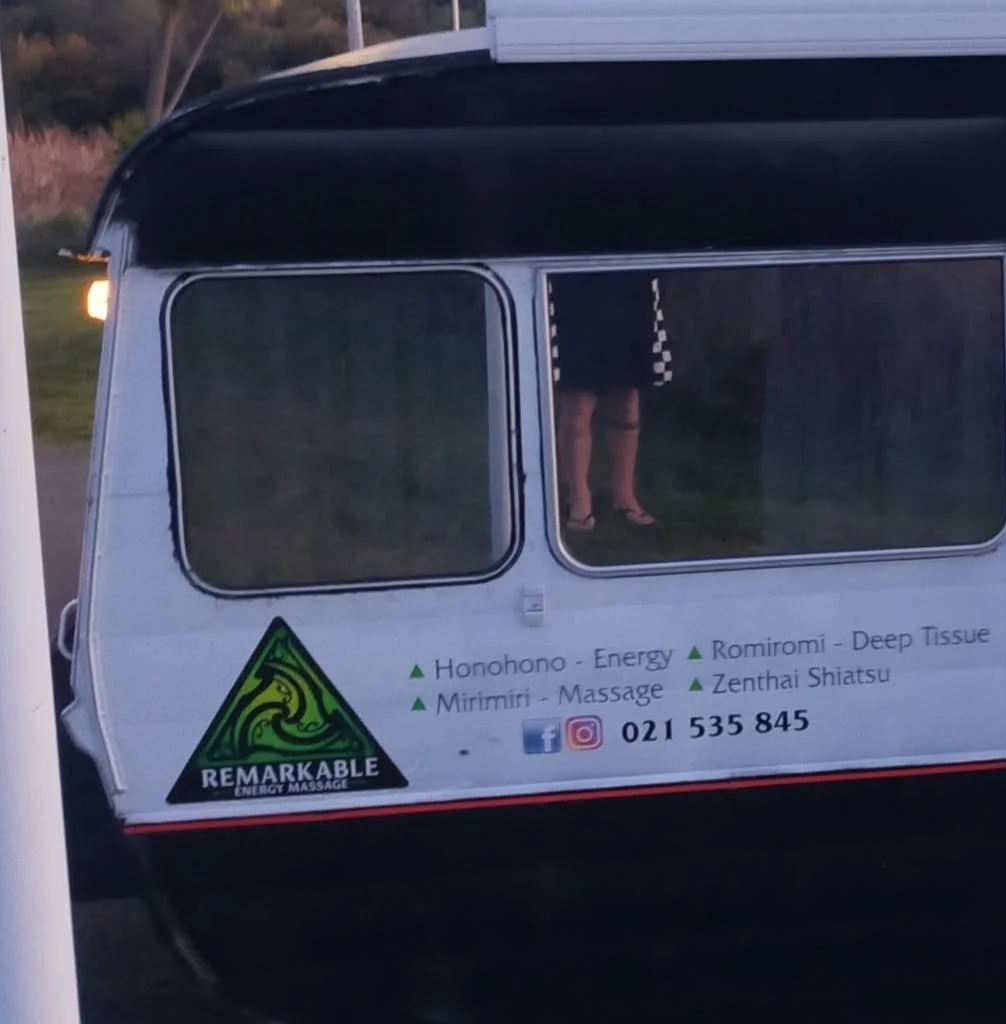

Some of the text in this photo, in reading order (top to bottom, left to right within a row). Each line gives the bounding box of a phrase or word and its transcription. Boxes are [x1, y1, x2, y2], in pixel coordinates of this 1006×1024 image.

[712, 634, 826, 661] Romiromi
[852, 630, 913, 654] Deep
[921, 626, 991, 648] Tissue
[435, 654, 566, 680] Honohono
[593, 647, 674, 672] Energy
[712, 666, 891, 695] Zenthai Shiatsu
[436, 688, 531, 715] Mirimiri
[558, 683, 664, 708] Massage
[621, 709, 810, 744] 021 535 845
[201, 756, 380, 789] REMARKABLE
[234, 777, 349, 798] ENERGY MASSAGE
